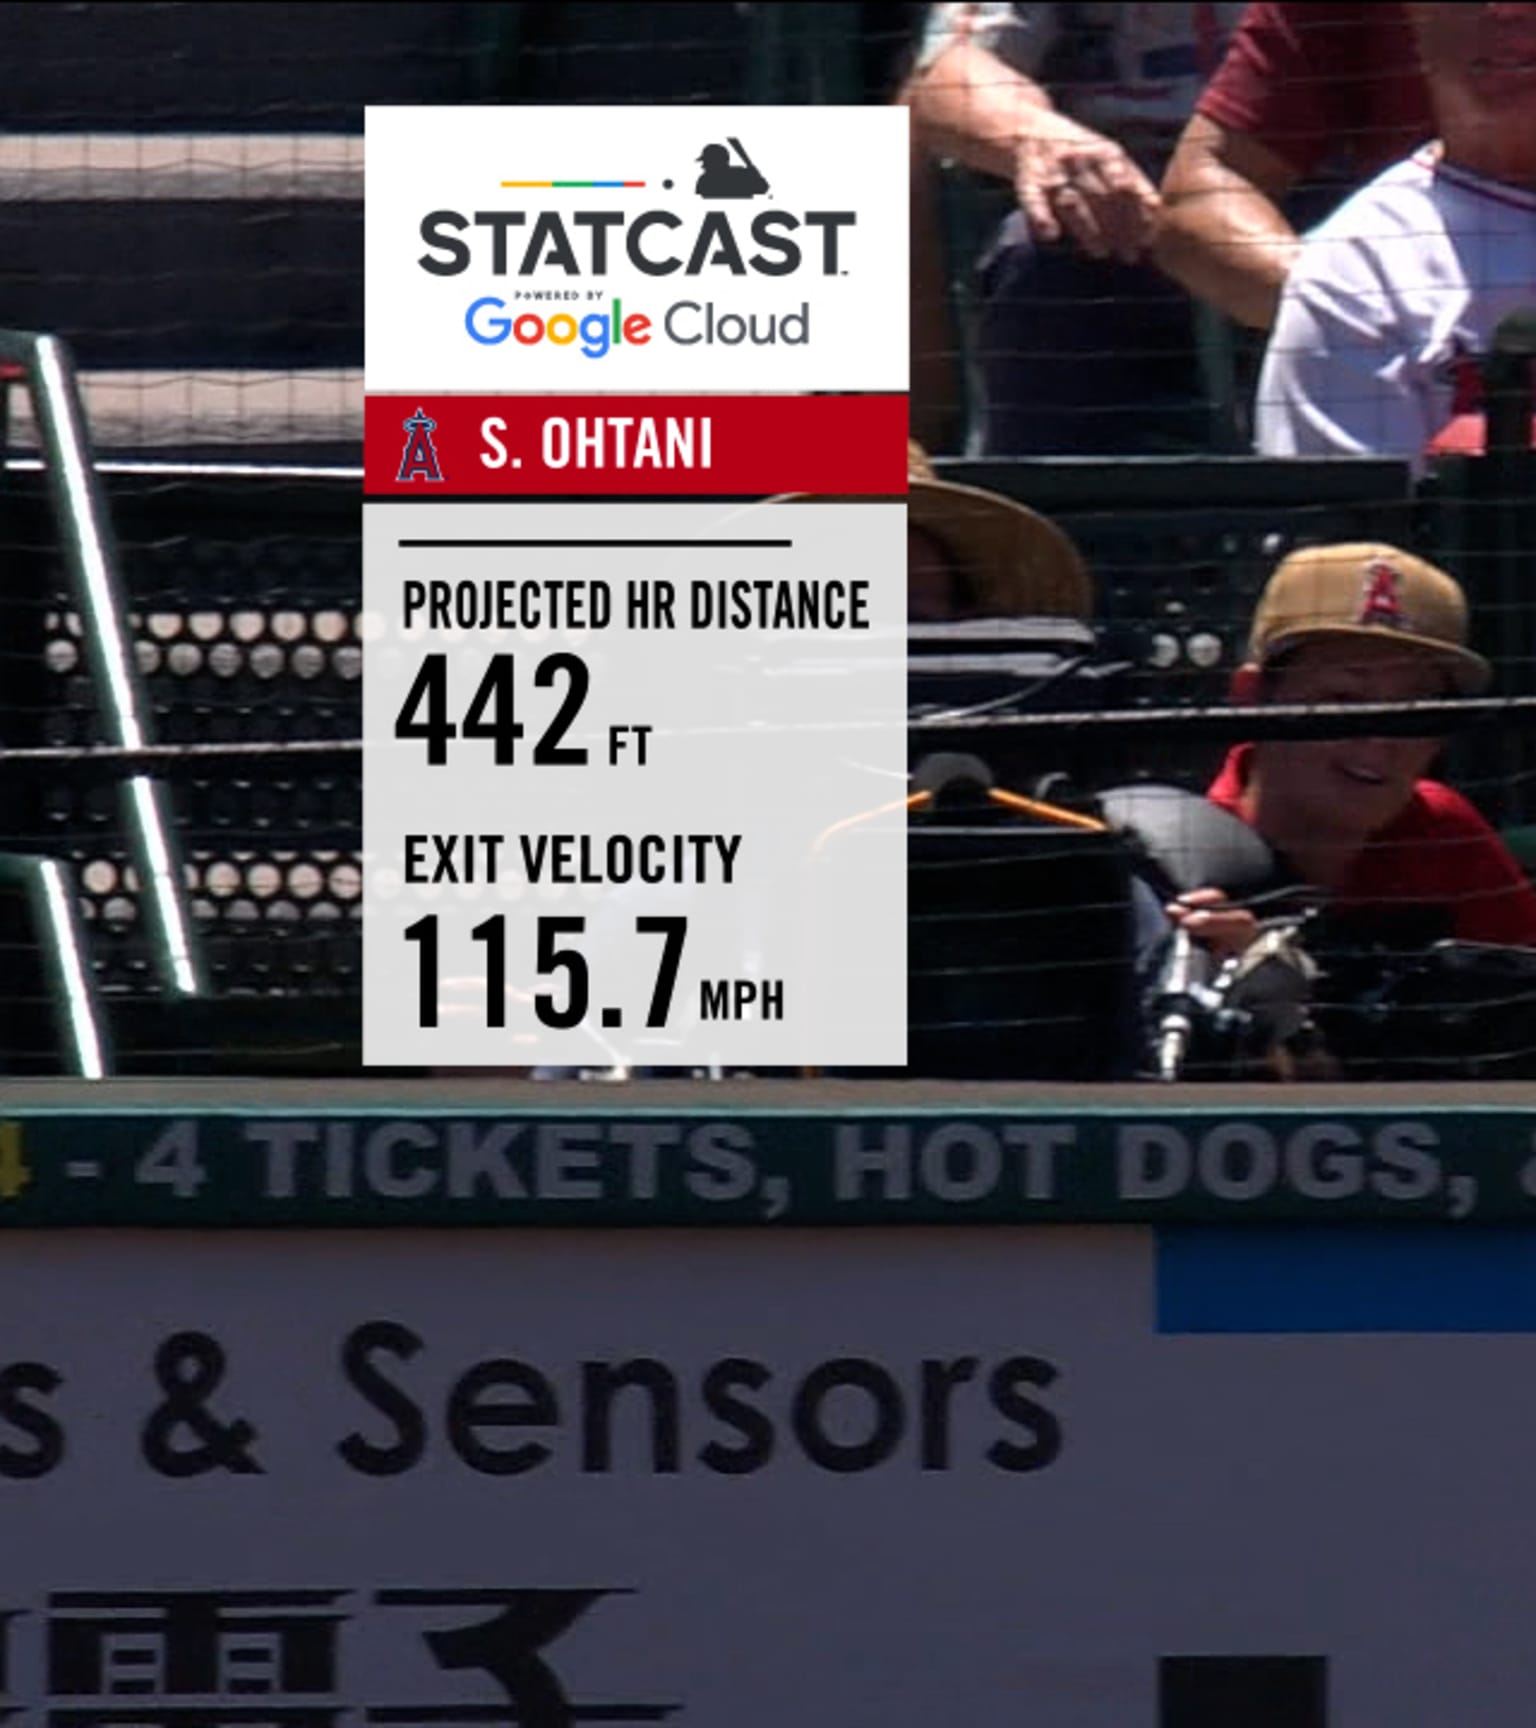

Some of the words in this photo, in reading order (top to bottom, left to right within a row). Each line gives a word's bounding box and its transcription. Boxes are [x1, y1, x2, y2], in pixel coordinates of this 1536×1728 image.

[134, 1121, 207, 1197] 4
[246, 1121, 792, 1218] TICKETS,
[834, 1122, 1077, 1200] HOT
[1117, 1121, 1480, 1216] DOGS,
[141, 1330, 268, 1480] &
[335, 1319, 1065, 1479] Sensors
